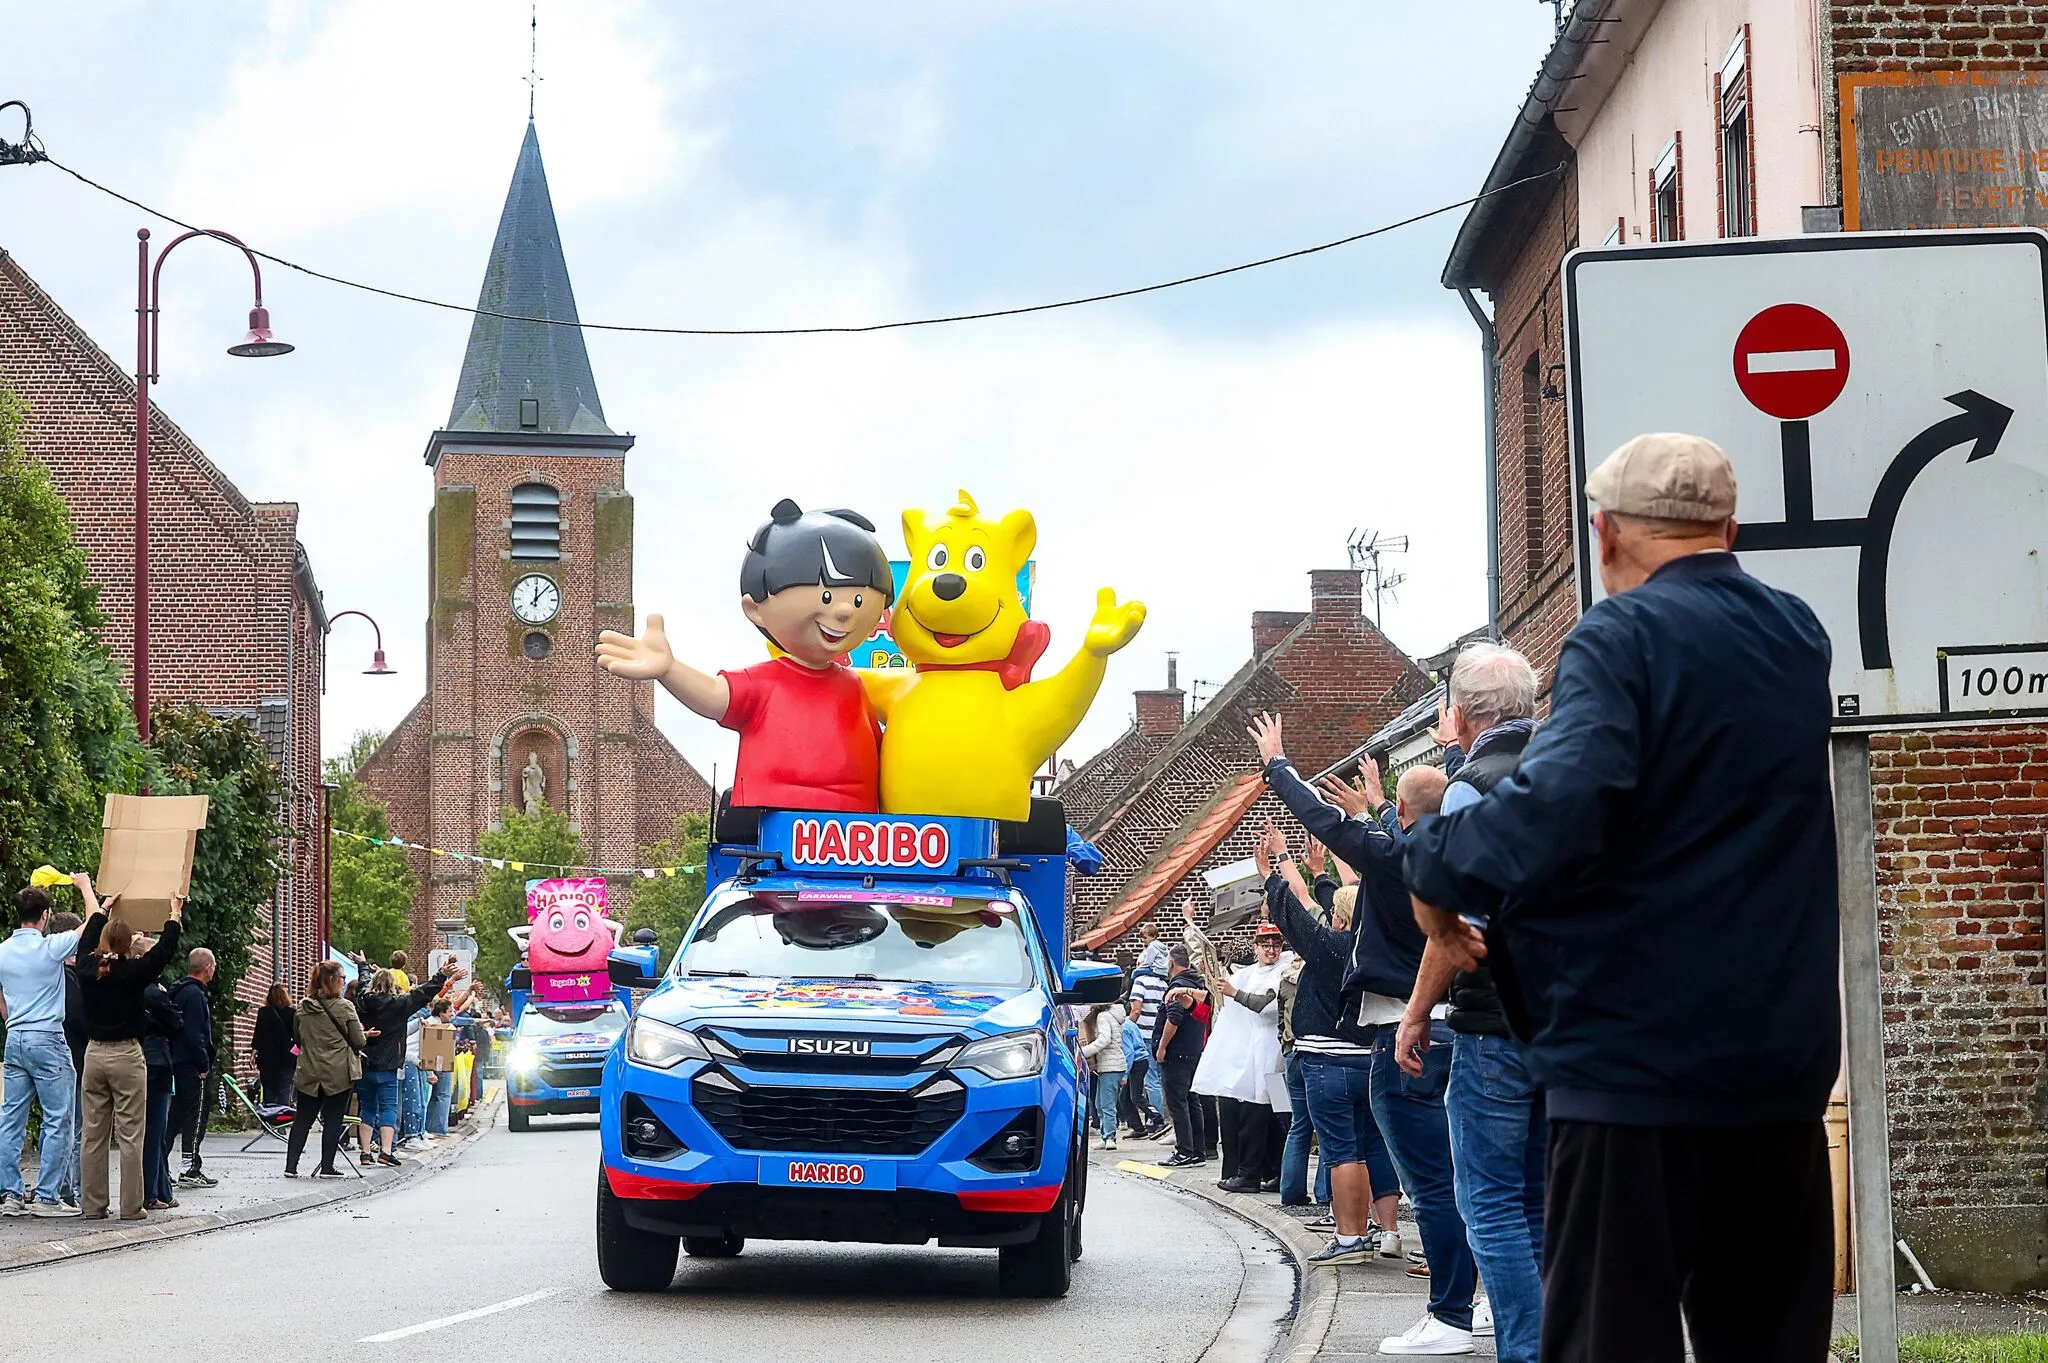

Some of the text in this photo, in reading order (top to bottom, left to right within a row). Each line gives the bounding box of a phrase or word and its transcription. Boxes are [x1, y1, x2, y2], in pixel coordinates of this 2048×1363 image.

[1876, 148, 2006, 174] PEINTURE
[1961, 666, 2048, 697] 100m
[794, 820, 948, 867] HARIBO
[912, 895, 945, 906] 3252
[788, 1038, 870, 1055] ISUZU
[566, 1089, 591, 1098] HARIBO
[789, 1162, 863, 1185] HARIBO
